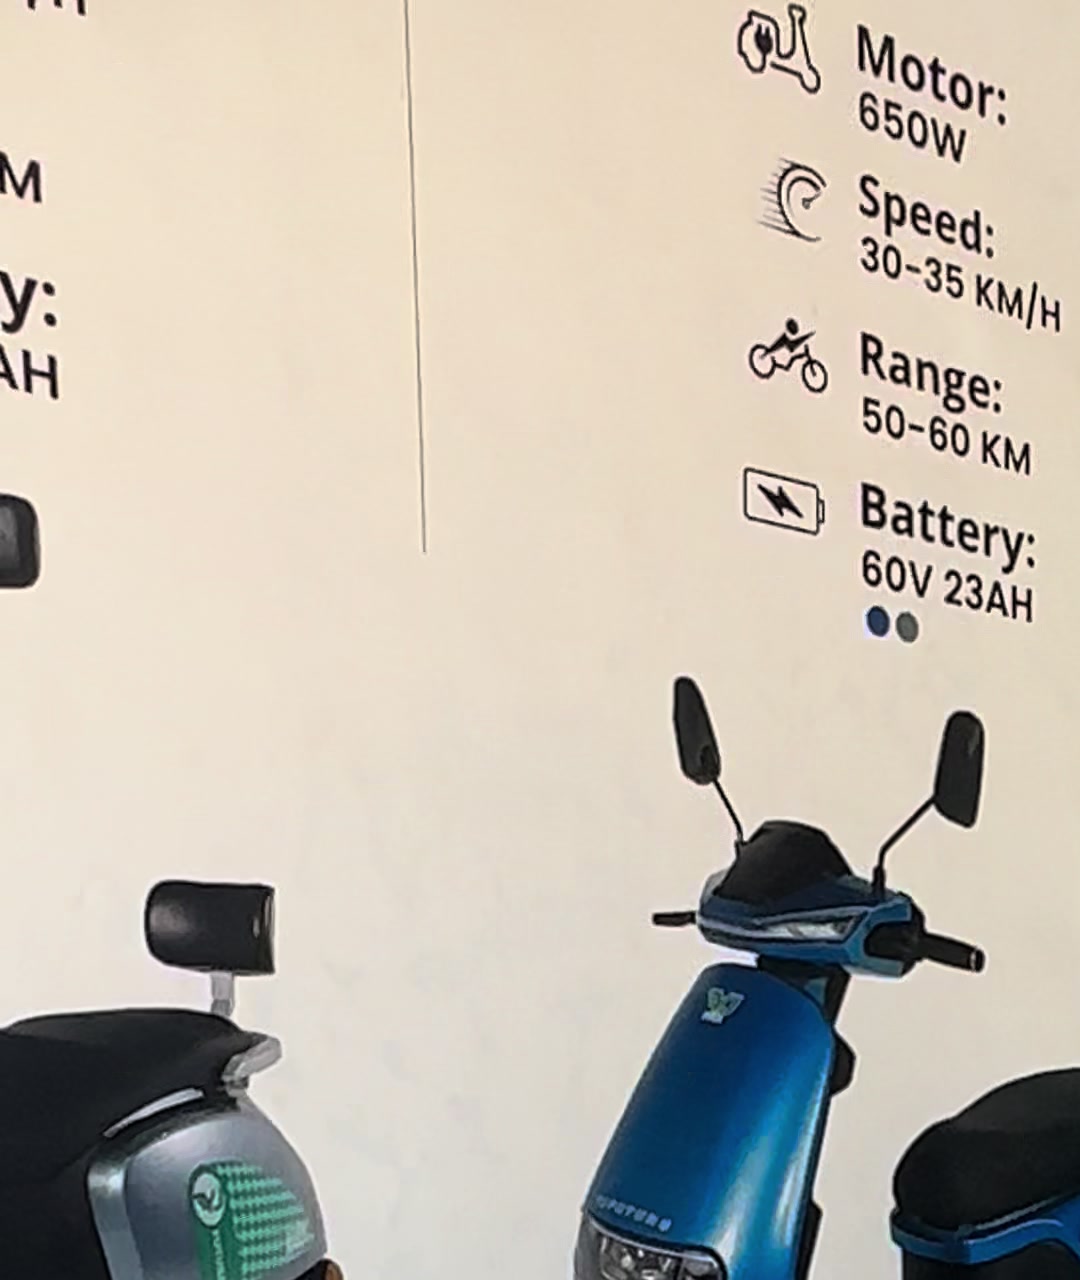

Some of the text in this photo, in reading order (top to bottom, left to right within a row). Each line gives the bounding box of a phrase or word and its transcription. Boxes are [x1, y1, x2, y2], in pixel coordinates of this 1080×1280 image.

[857, 24, 1008, 125] Motor:
[858, 92, 966, 163] 650W
[859, 174, 995, 258] Speed:
[860, 237, 1062, 332] 30-35 KM/H
[860, 331, 1003, 414] Range:
[862, 397, 1032, 476] 50-60 KM
[861, 482, 1037, 574] Battery:
[863, 550, 1034, 624] 60V 23AH
